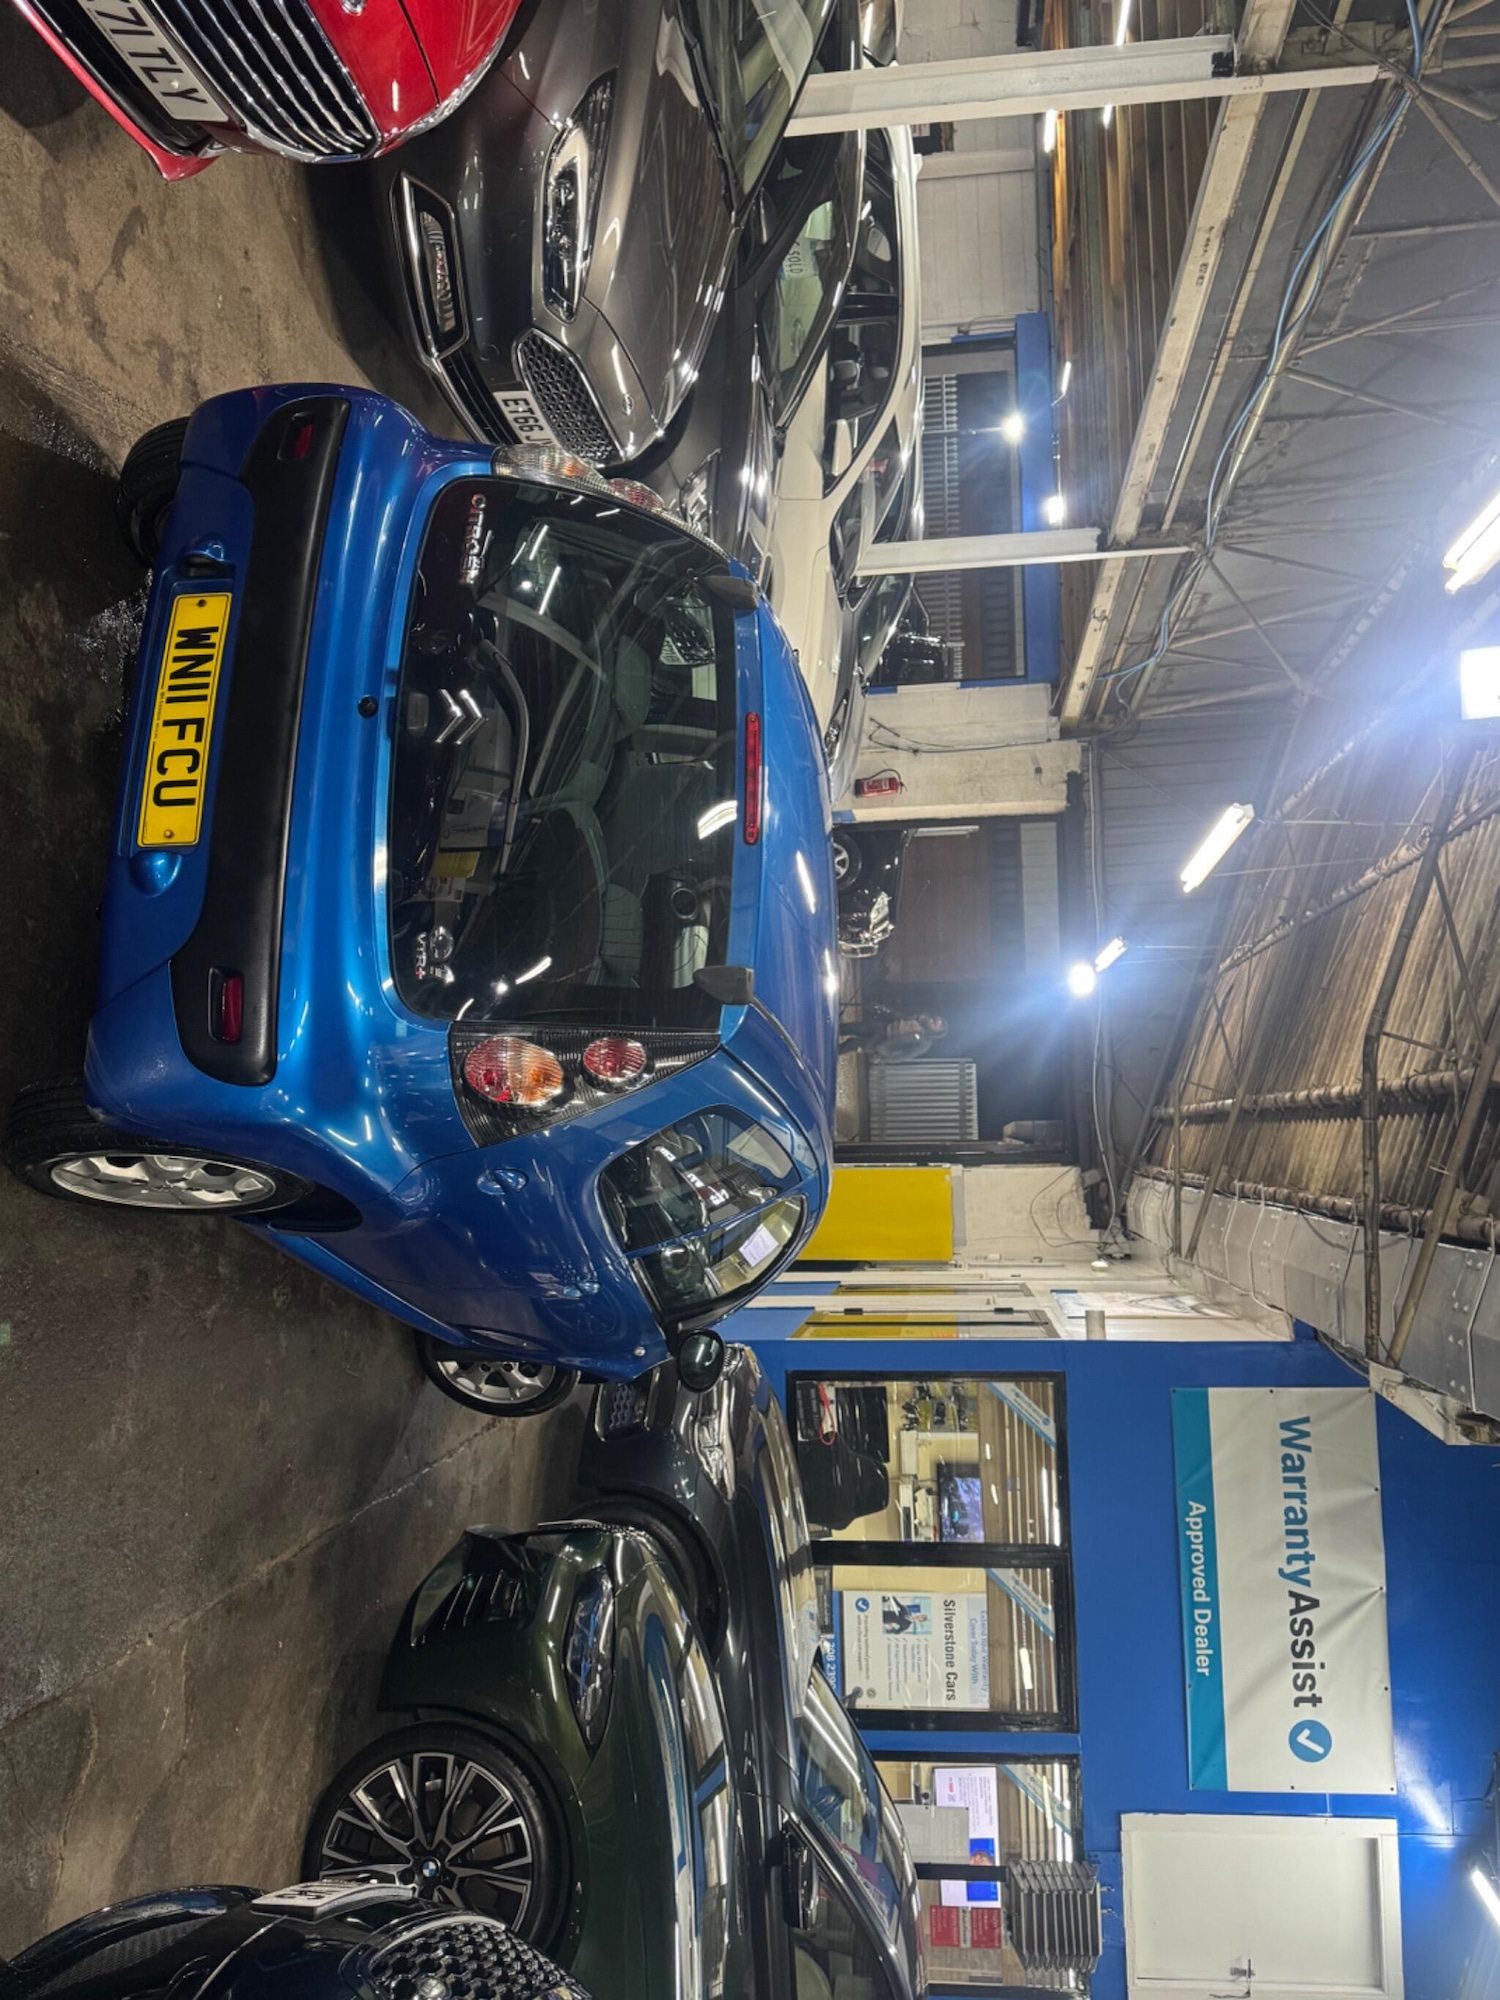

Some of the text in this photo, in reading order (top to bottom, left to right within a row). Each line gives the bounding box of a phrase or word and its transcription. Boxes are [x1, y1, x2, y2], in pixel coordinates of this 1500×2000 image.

[87, 0, 155, 37] 71
[127, 47, 208, 104] TLY
[788, 250, 803, 274] SOLD
[501, 398, 544, 432] ET66
[459, 494, 486, 584] CITROËN
[153, 626, 219, 807] WN11 FCU
[415, 932, 427, 980] VTR+
[1185, 1501, 1213, 1676] Approved Dealer
[943, 1600, 958, 1701] Silverstone Cars
[969, 1618, 980, 1684] Cover Today With
